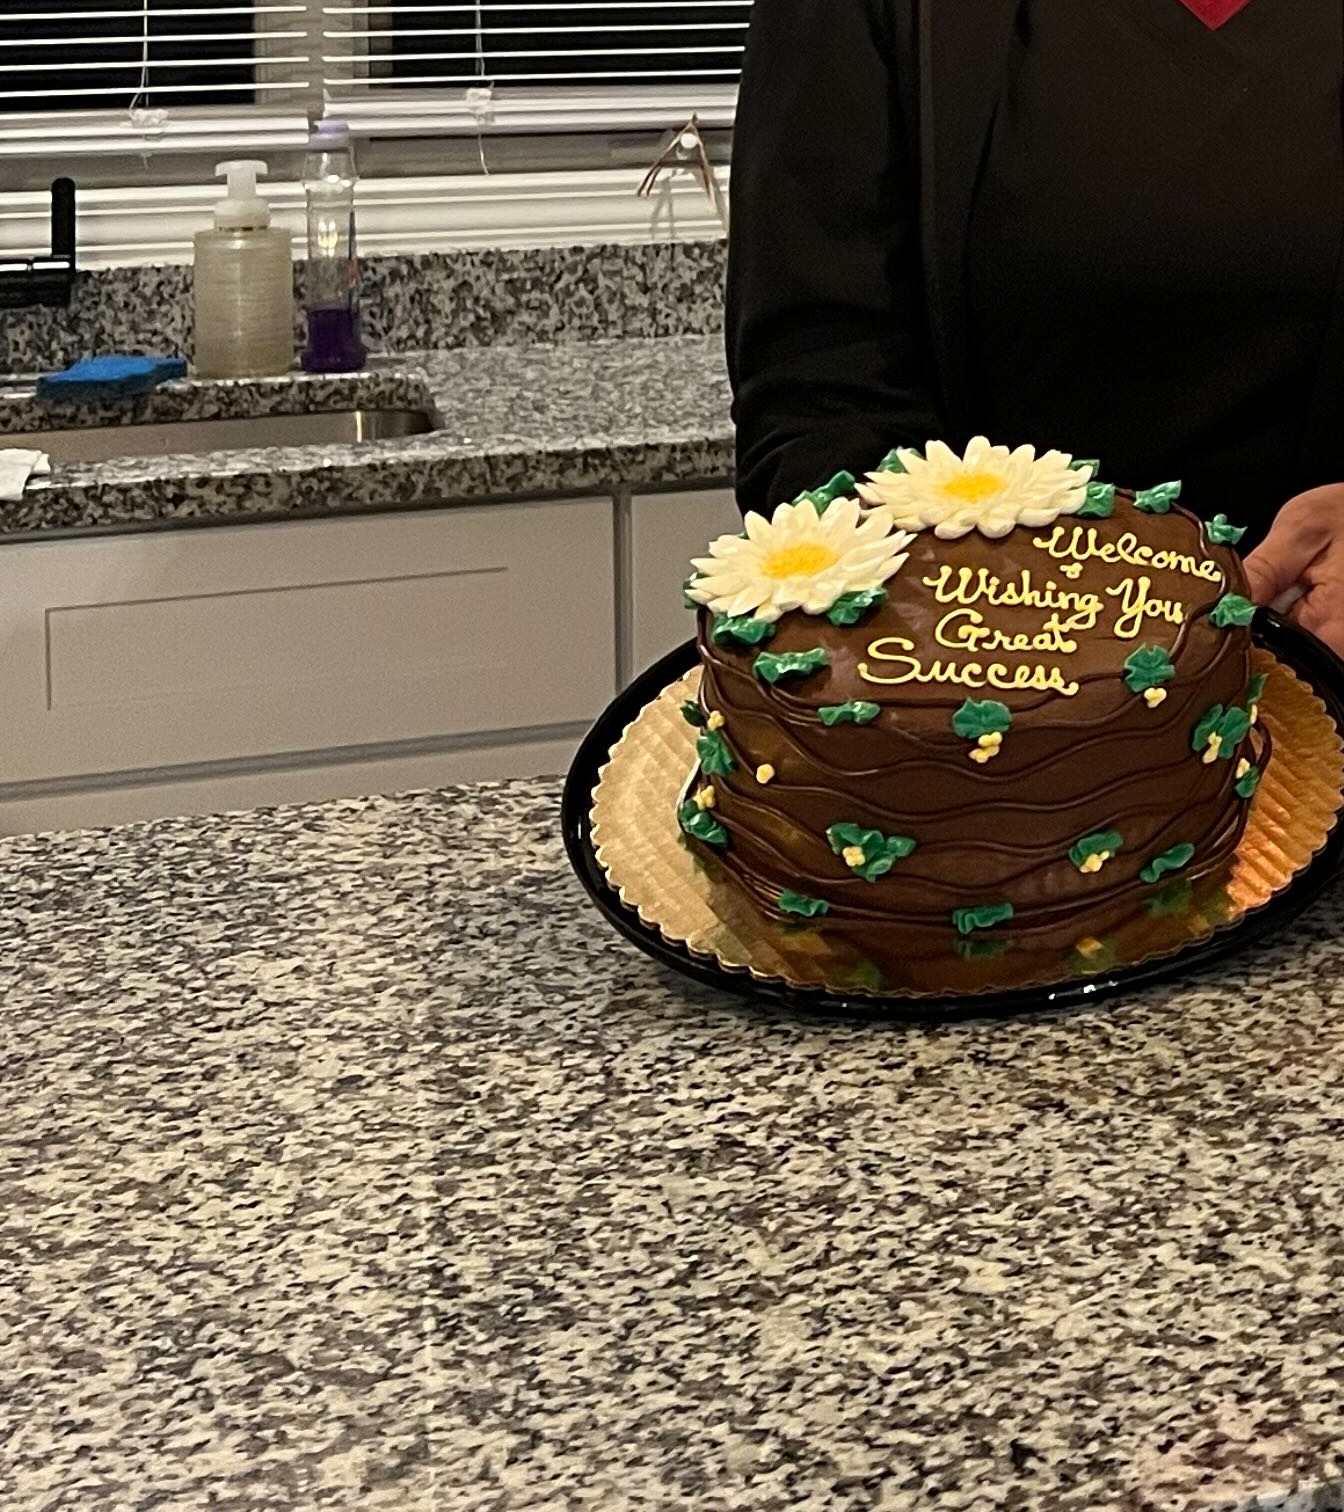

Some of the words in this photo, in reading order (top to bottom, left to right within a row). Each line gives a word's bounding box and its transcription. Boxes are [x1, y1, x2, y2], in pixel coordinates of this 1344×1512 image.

[1033, 526, 1222, 582] Welcome
[923, 564, 1104, 630] Wishing
[1106, 576, 1184, 639] You
[935, 607, 1078, 654] Great
[858, 636, 1079, 696] Success
